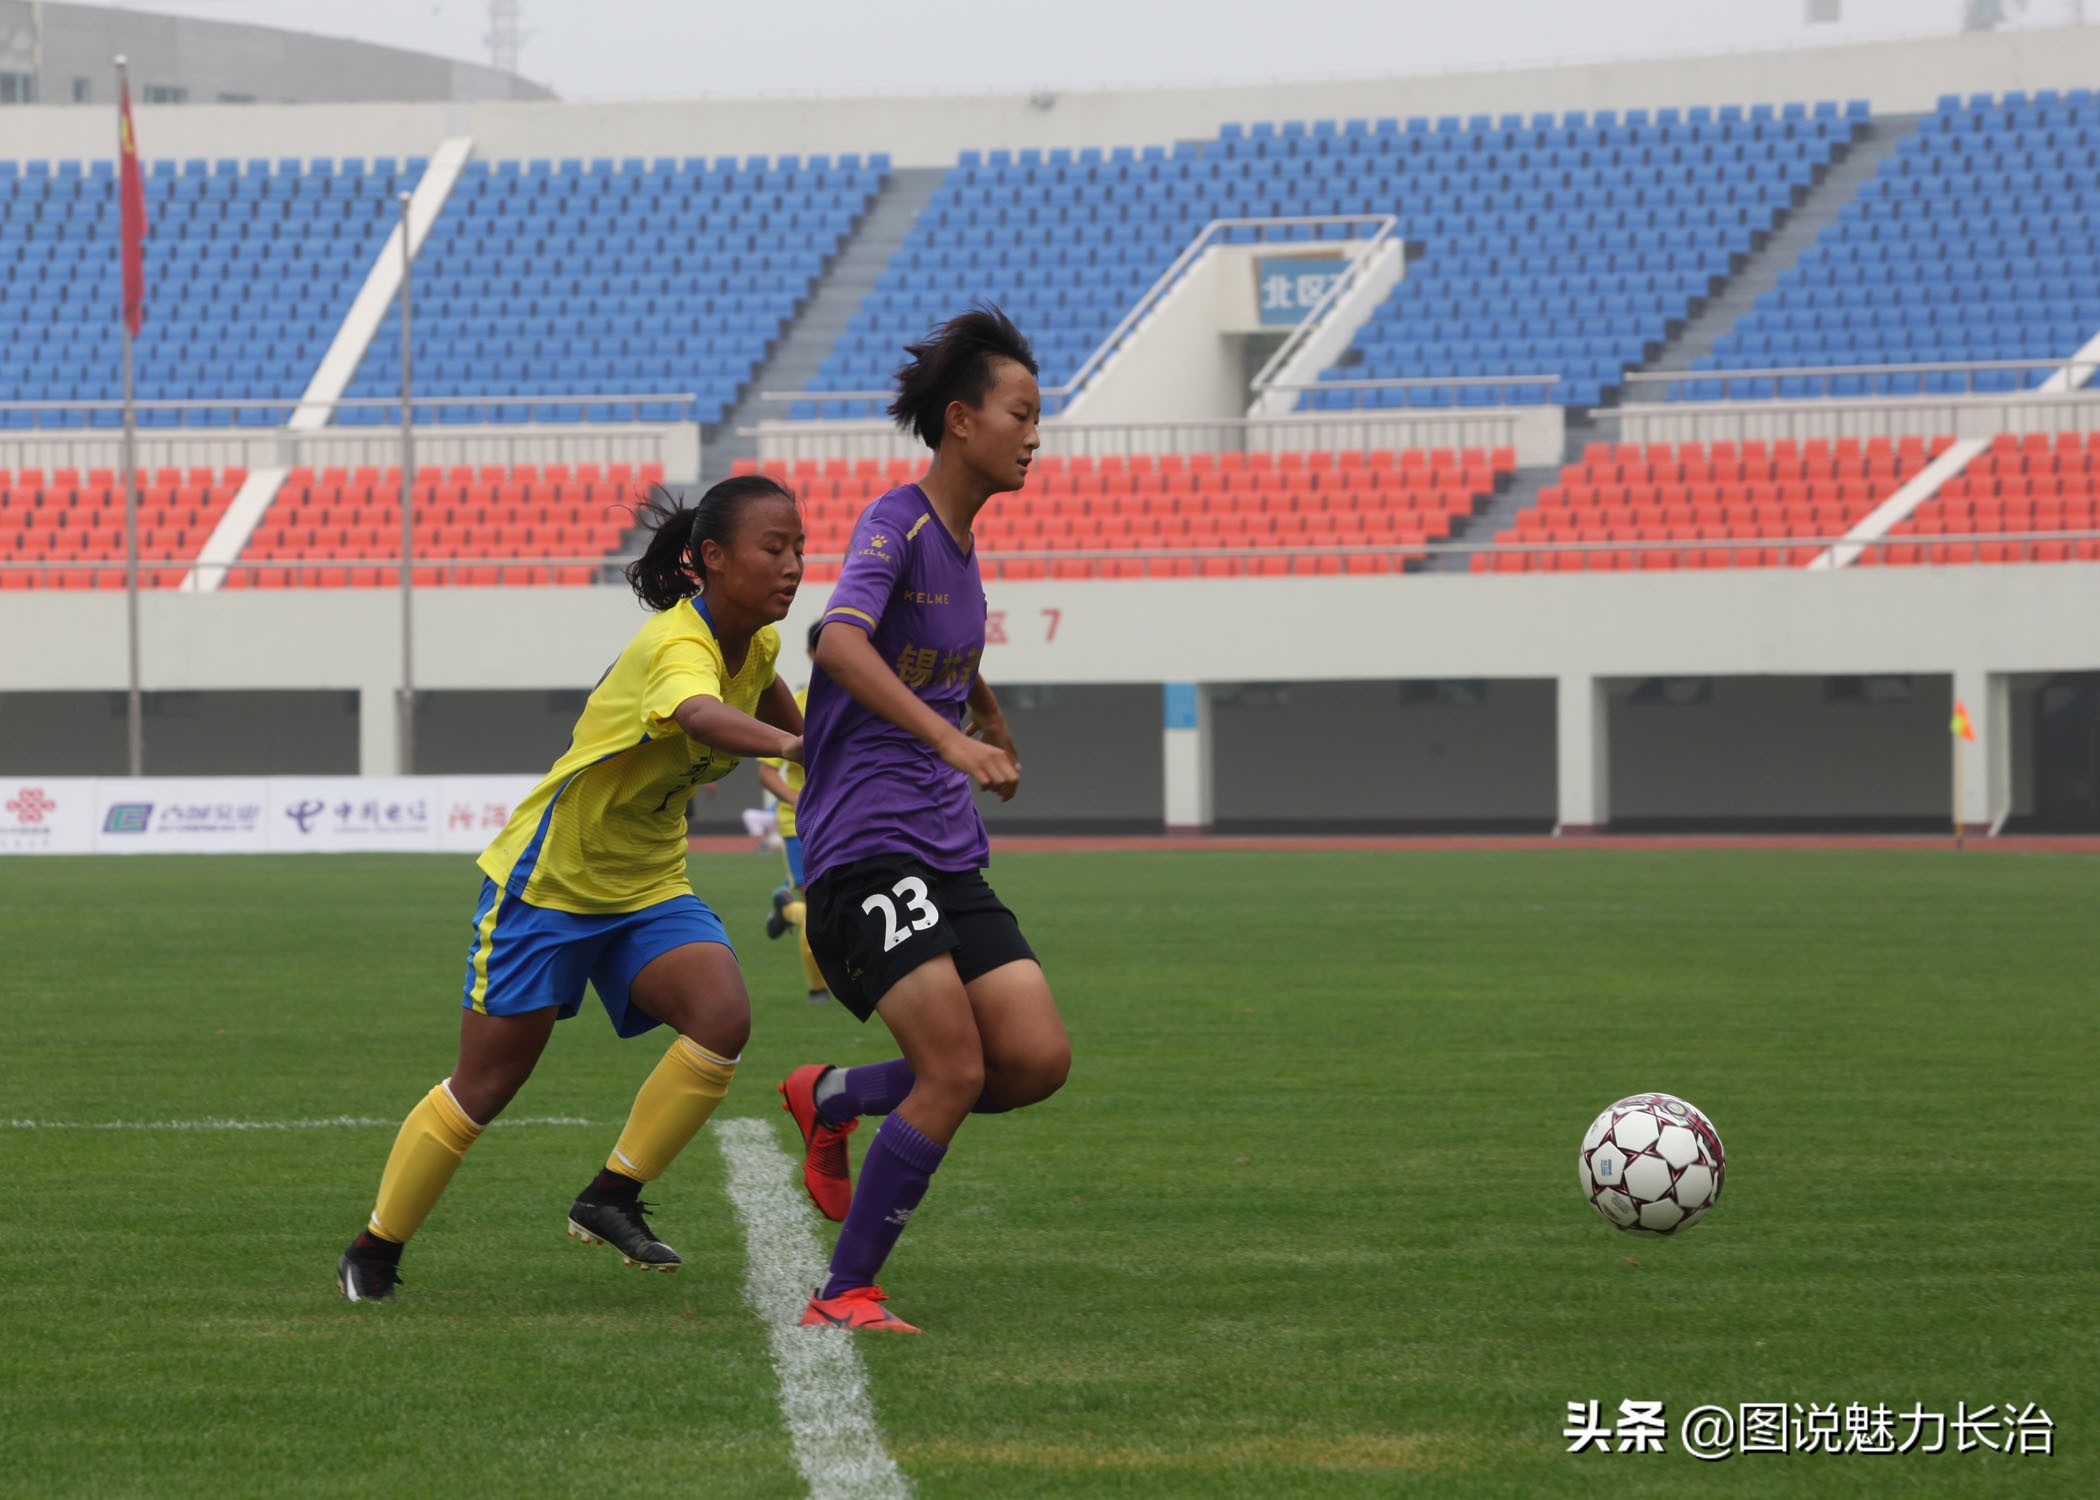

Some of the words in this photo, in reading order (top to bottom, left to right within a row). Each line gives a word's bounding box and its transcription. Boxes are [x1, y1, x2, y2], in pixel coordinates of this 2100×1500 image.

[904, 591, 950, 605] KELME
[1041, 608, 1062, 643] 7
[862, 876, 939, 952] 23
